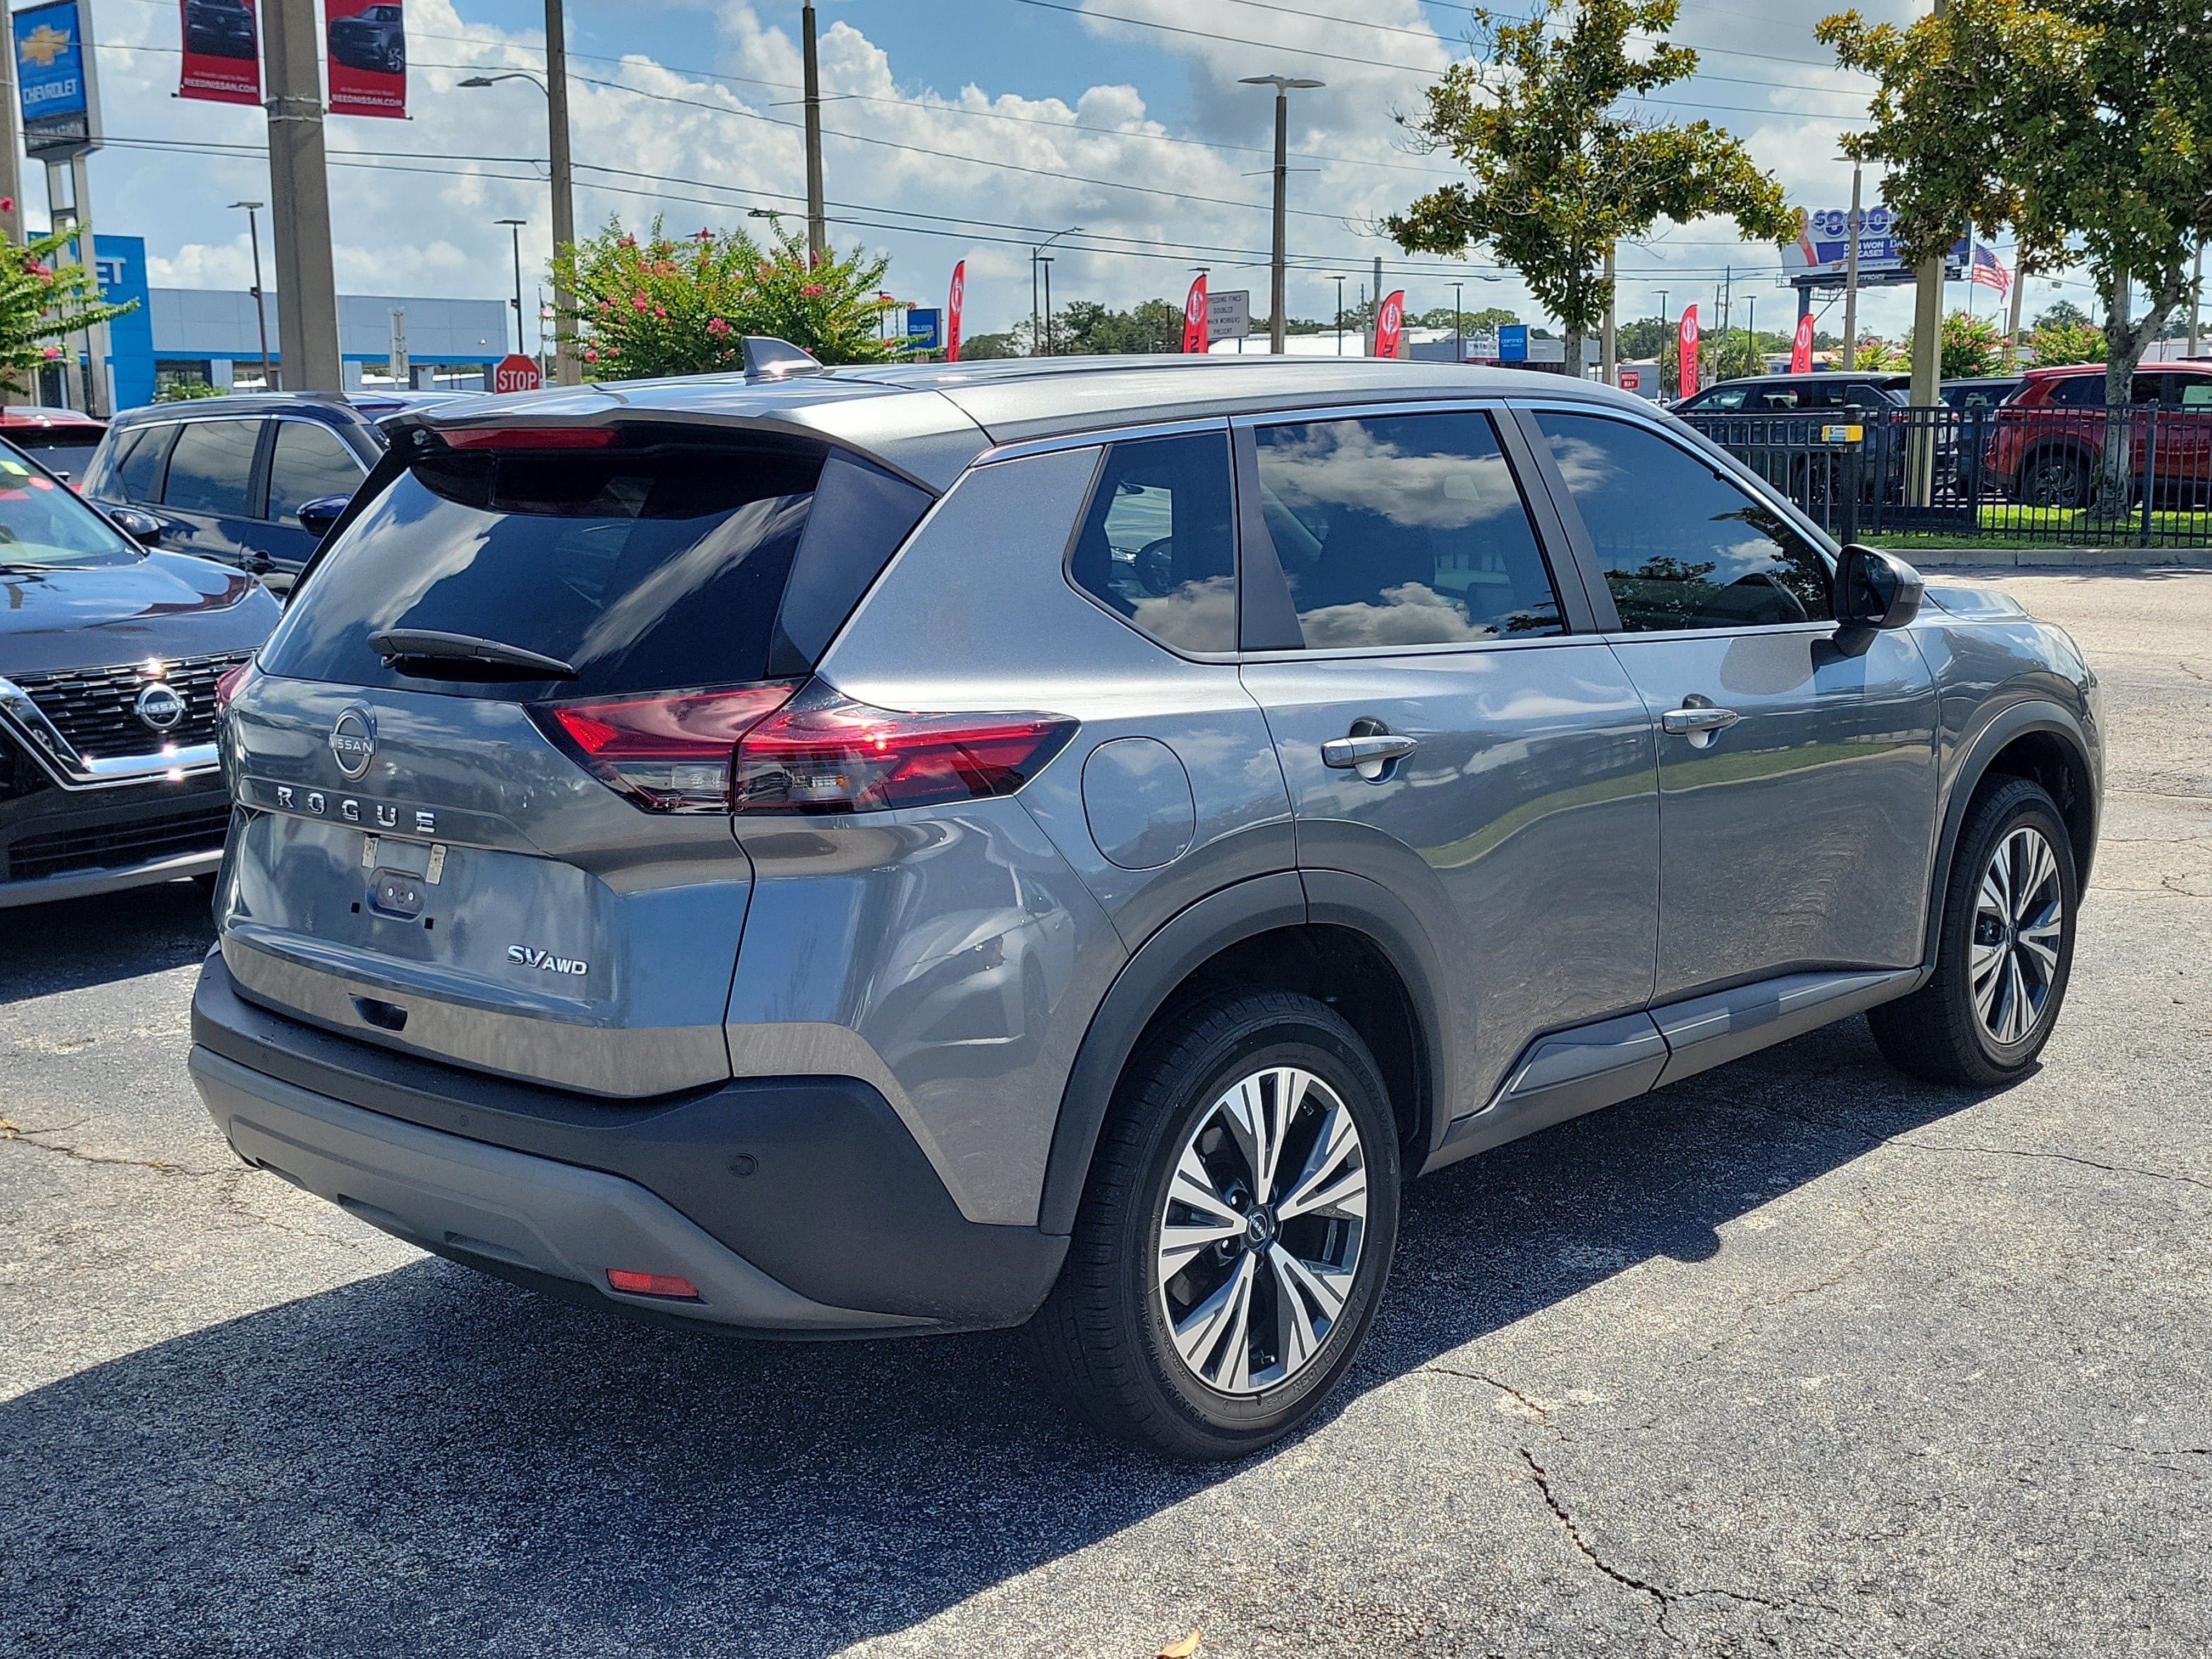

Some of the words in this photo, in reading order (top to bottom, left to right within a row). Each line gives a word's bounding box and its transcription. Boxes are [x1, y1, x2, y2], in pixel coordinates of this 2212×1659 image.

[22, 78, 77, 104] CHEVROLET
[1863, 240, 1884, 250] WON
[498, 369, 538, 391] STOP
[134, 698, 185, 715] NISSAN
[329, 735, 373, 753] NISSAN
[278, 786, 436, 833] ROGUE
[507, 944, 547, 968] SV
[541, 956, 588, 975] AWD
